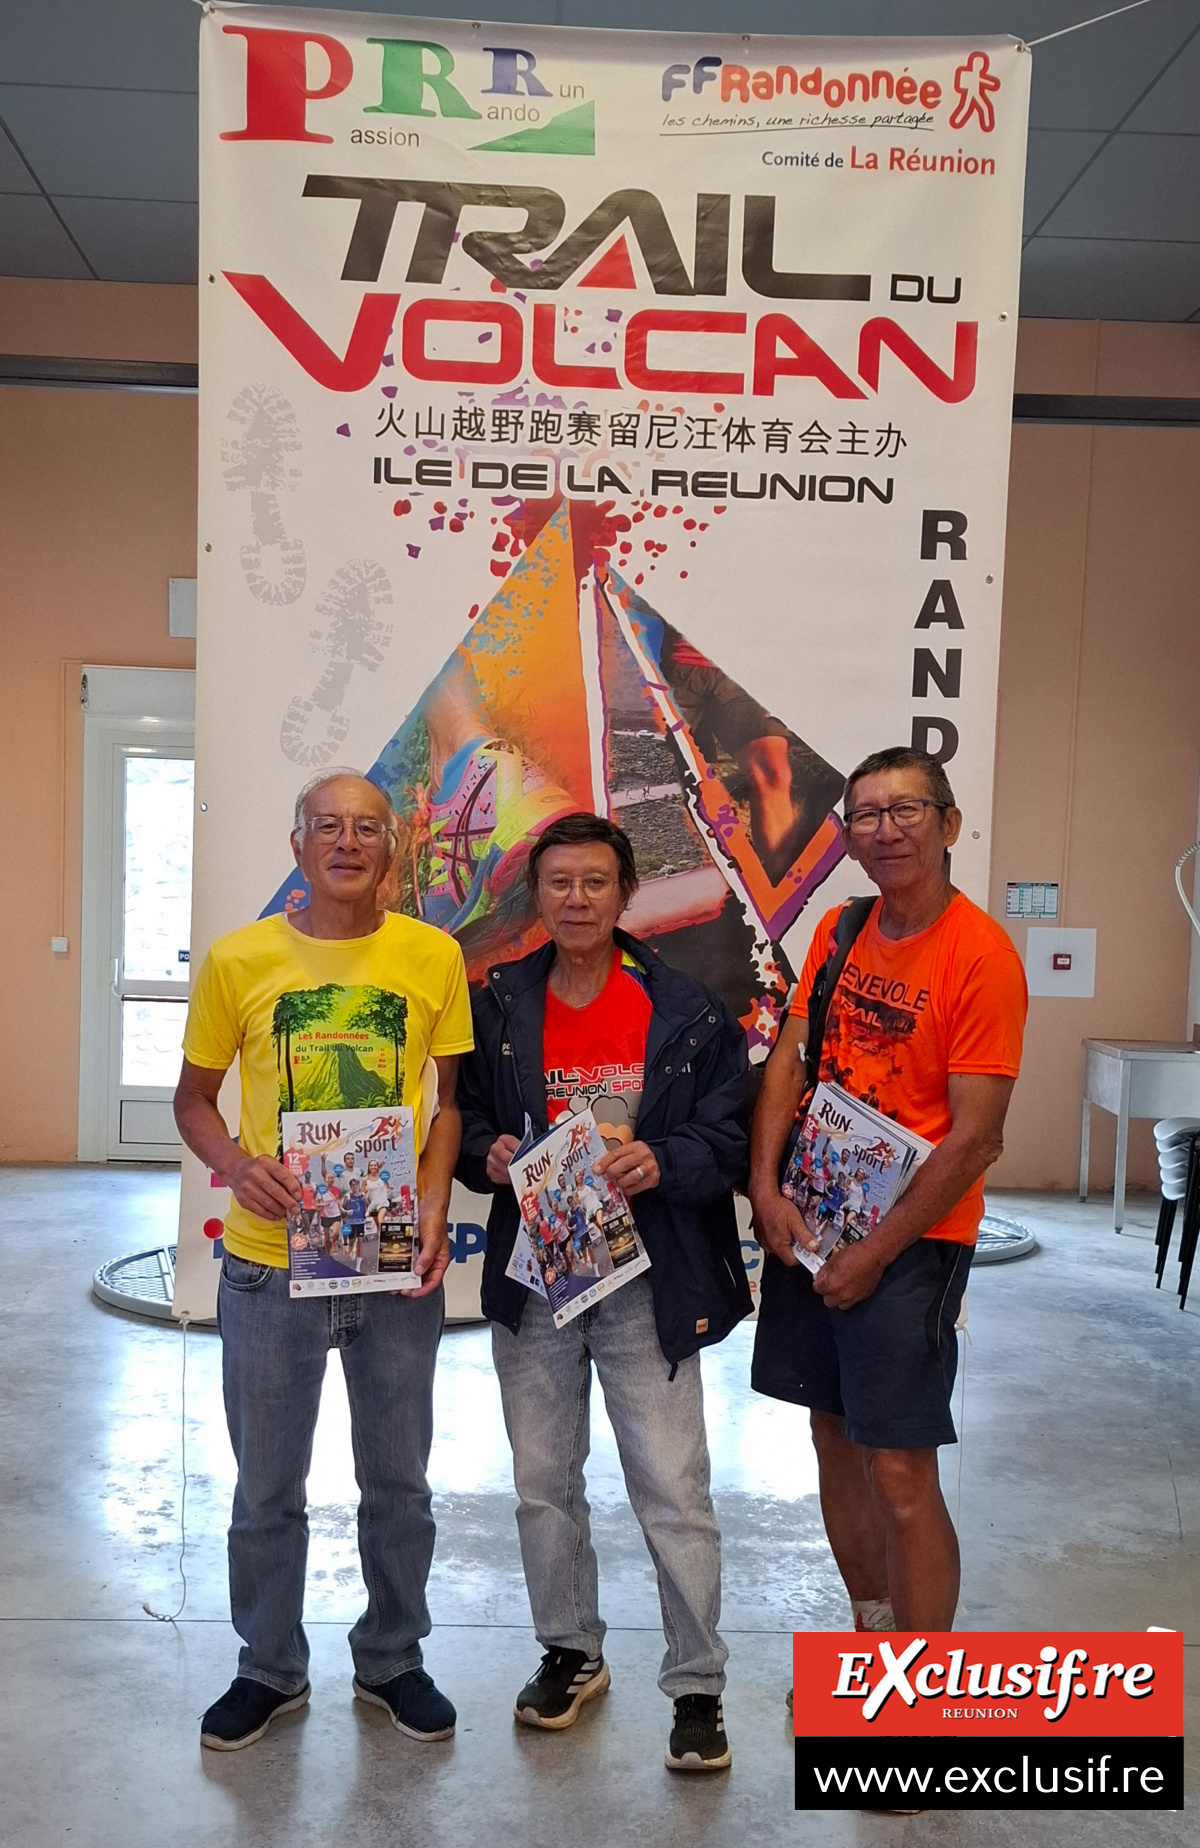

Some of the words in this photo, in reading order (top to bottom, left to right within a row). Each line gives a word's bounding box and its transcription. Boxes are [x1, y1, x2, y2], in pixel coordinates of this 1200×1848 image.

[559, 84, 585, 99] un
[661, 56, 942, 109] FFRandonnée
[486, 104, 540, 123] ando
[662, 113, 685, 127] les
[766, 116, 793, 126] une
[799, 112, 867, 127] richesse
[871, 111, 935, 130] partagée
[350, 126, 419, 148] assion
[761, 151, 820, 168] Comité
[824, 153, 844, 168] de
[850, 146, 878, 170] La
[889, 147, 995, 175] Réunion
[302, 174, 871, 301] TRAIL
[890, 273, 962, 304] DU
[221, 270, 979, 404] VOLCAN
[375, 402, 908, 459] 火山越野跑赛留尼汪体育会主办
[373, 456, 453, 488] ILE
[471, 461, 549, 491] DE
[566, 464, 632, 495] LA
[651, 468, 895, 505] REUNION
[842, 962, 930, 1012] ENEVOLE
[840, 994, 882, 1028] RAIL
[295, 1045, 307, 1053] du
[309, 1044, 330, 1053] Trail
[332, 1044, 343, 1052] du
[346, 1043, 374, 1053] Volcan
[298, 1032, 312, 1040] Les
[315, 1031, 369, 1040] Randonnées
[611, 1080, 645, 1093] SPO
[355, 1135, 397, 1158] sport
[560, 1141, 591, 1173] sport
[852, 1143, 886, 1175] sport
